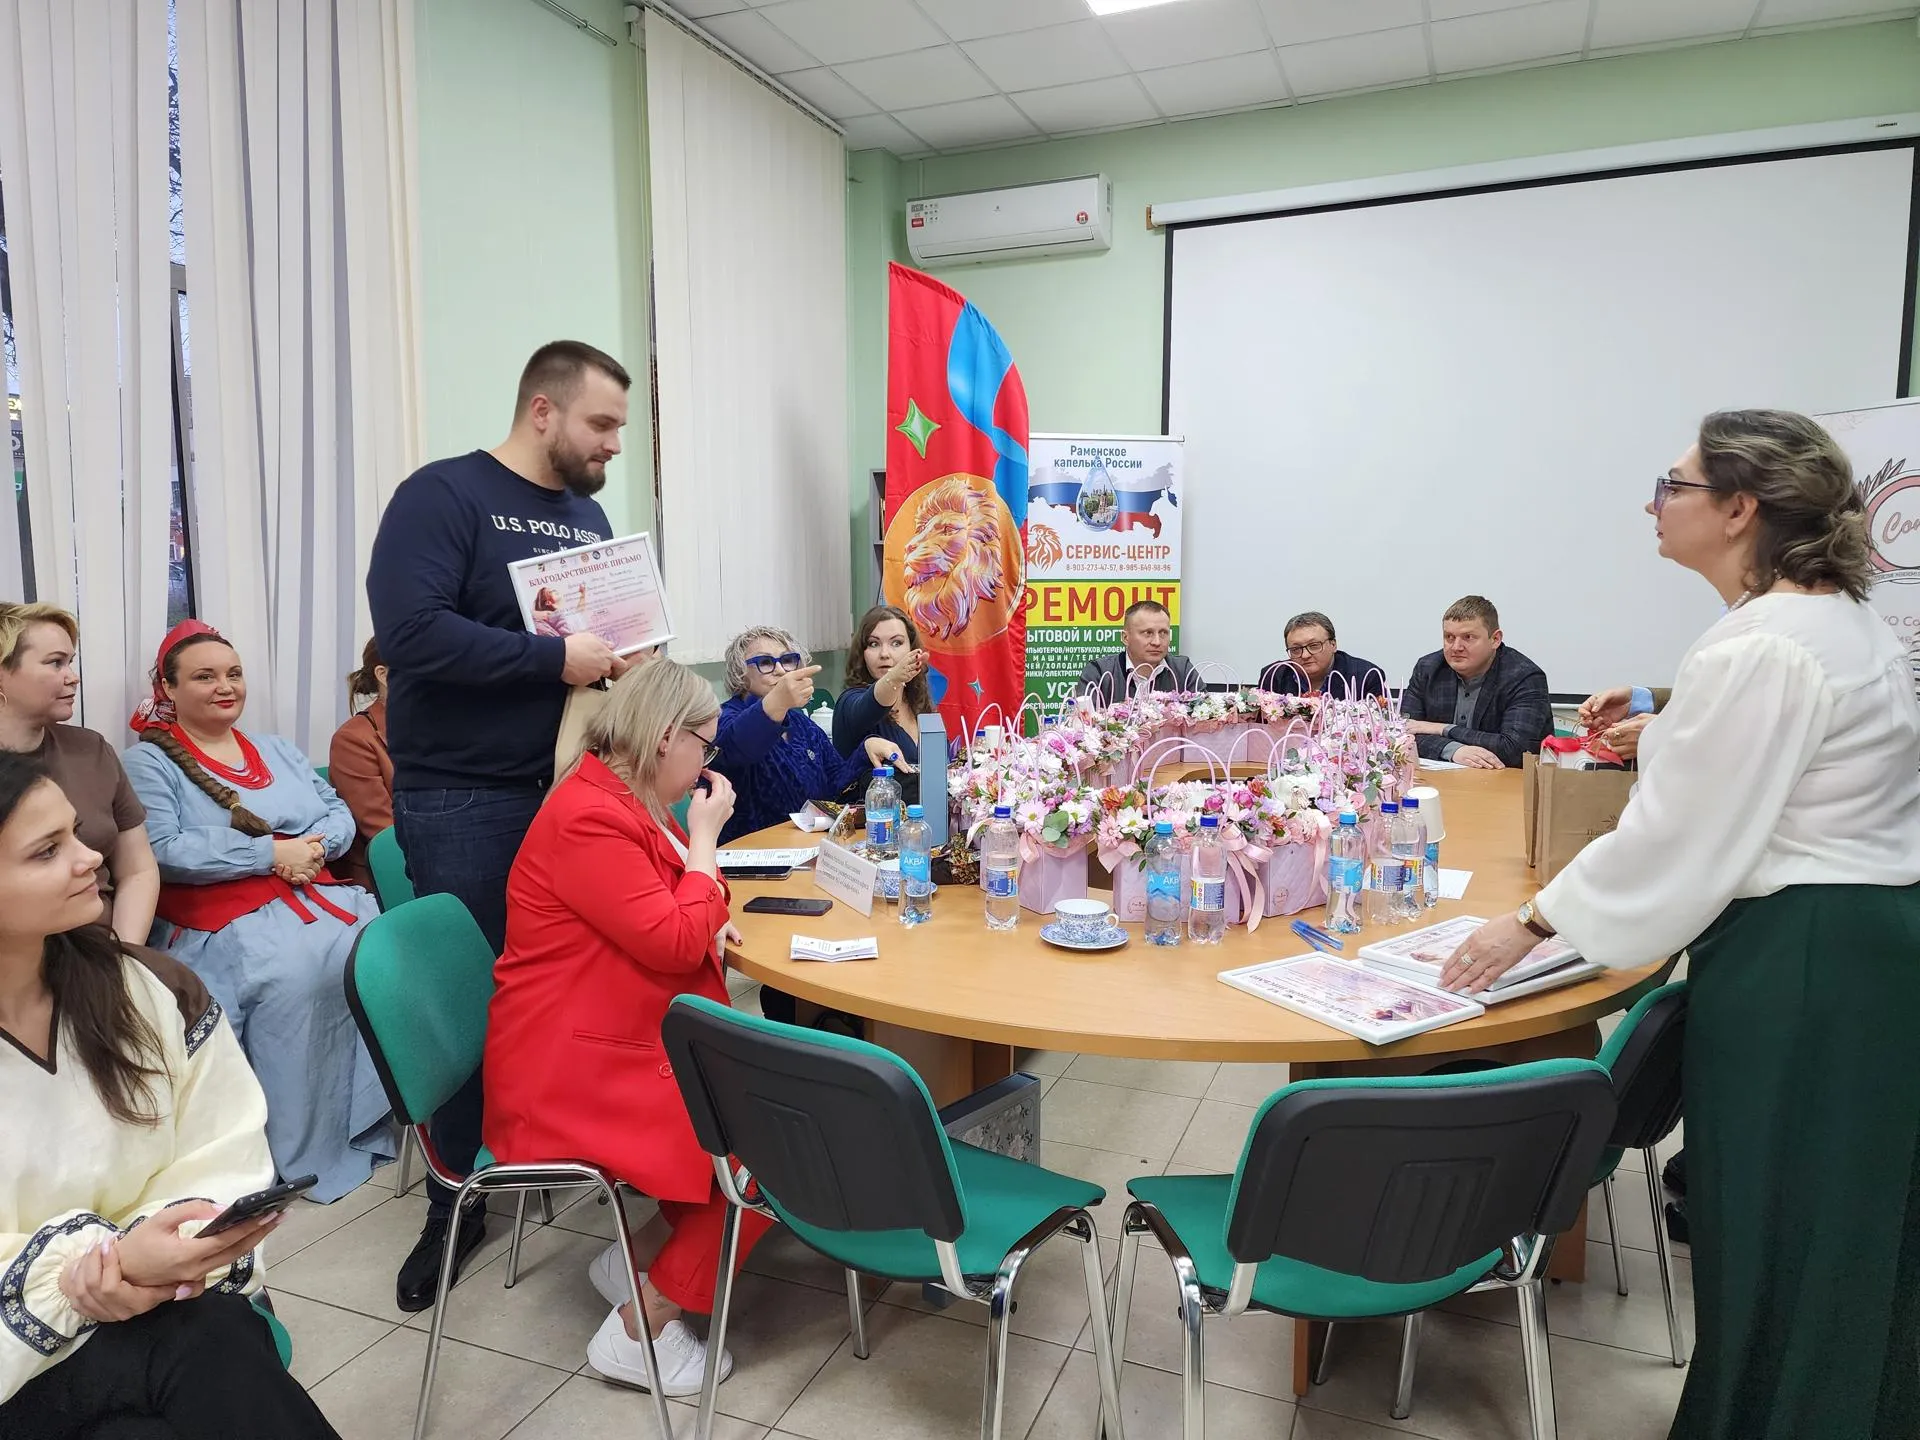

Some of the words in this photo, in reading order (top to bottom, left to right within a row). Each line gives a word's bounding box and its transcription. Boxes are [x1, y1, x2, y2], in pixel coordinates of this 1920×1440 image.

[1070, 445, 1127, 457] Раменское
[1054, 458, 1102, 468] капелька
[1105, 458, 1142, 468] России
[491, 514, 526, 533] U.S.
[527, 519, 571, 540] POLO
[1066, 544, 1171, 561] СЕРВИС-ЦЕНТР
[528, 560, 610, 588] БЛАГОДАРСТВЕННОЕ
[610, 553, 642, 568] ПИСЬМО
[1083, 629, 1093, 642] И
[903, 857, 926, 866] АКВА
